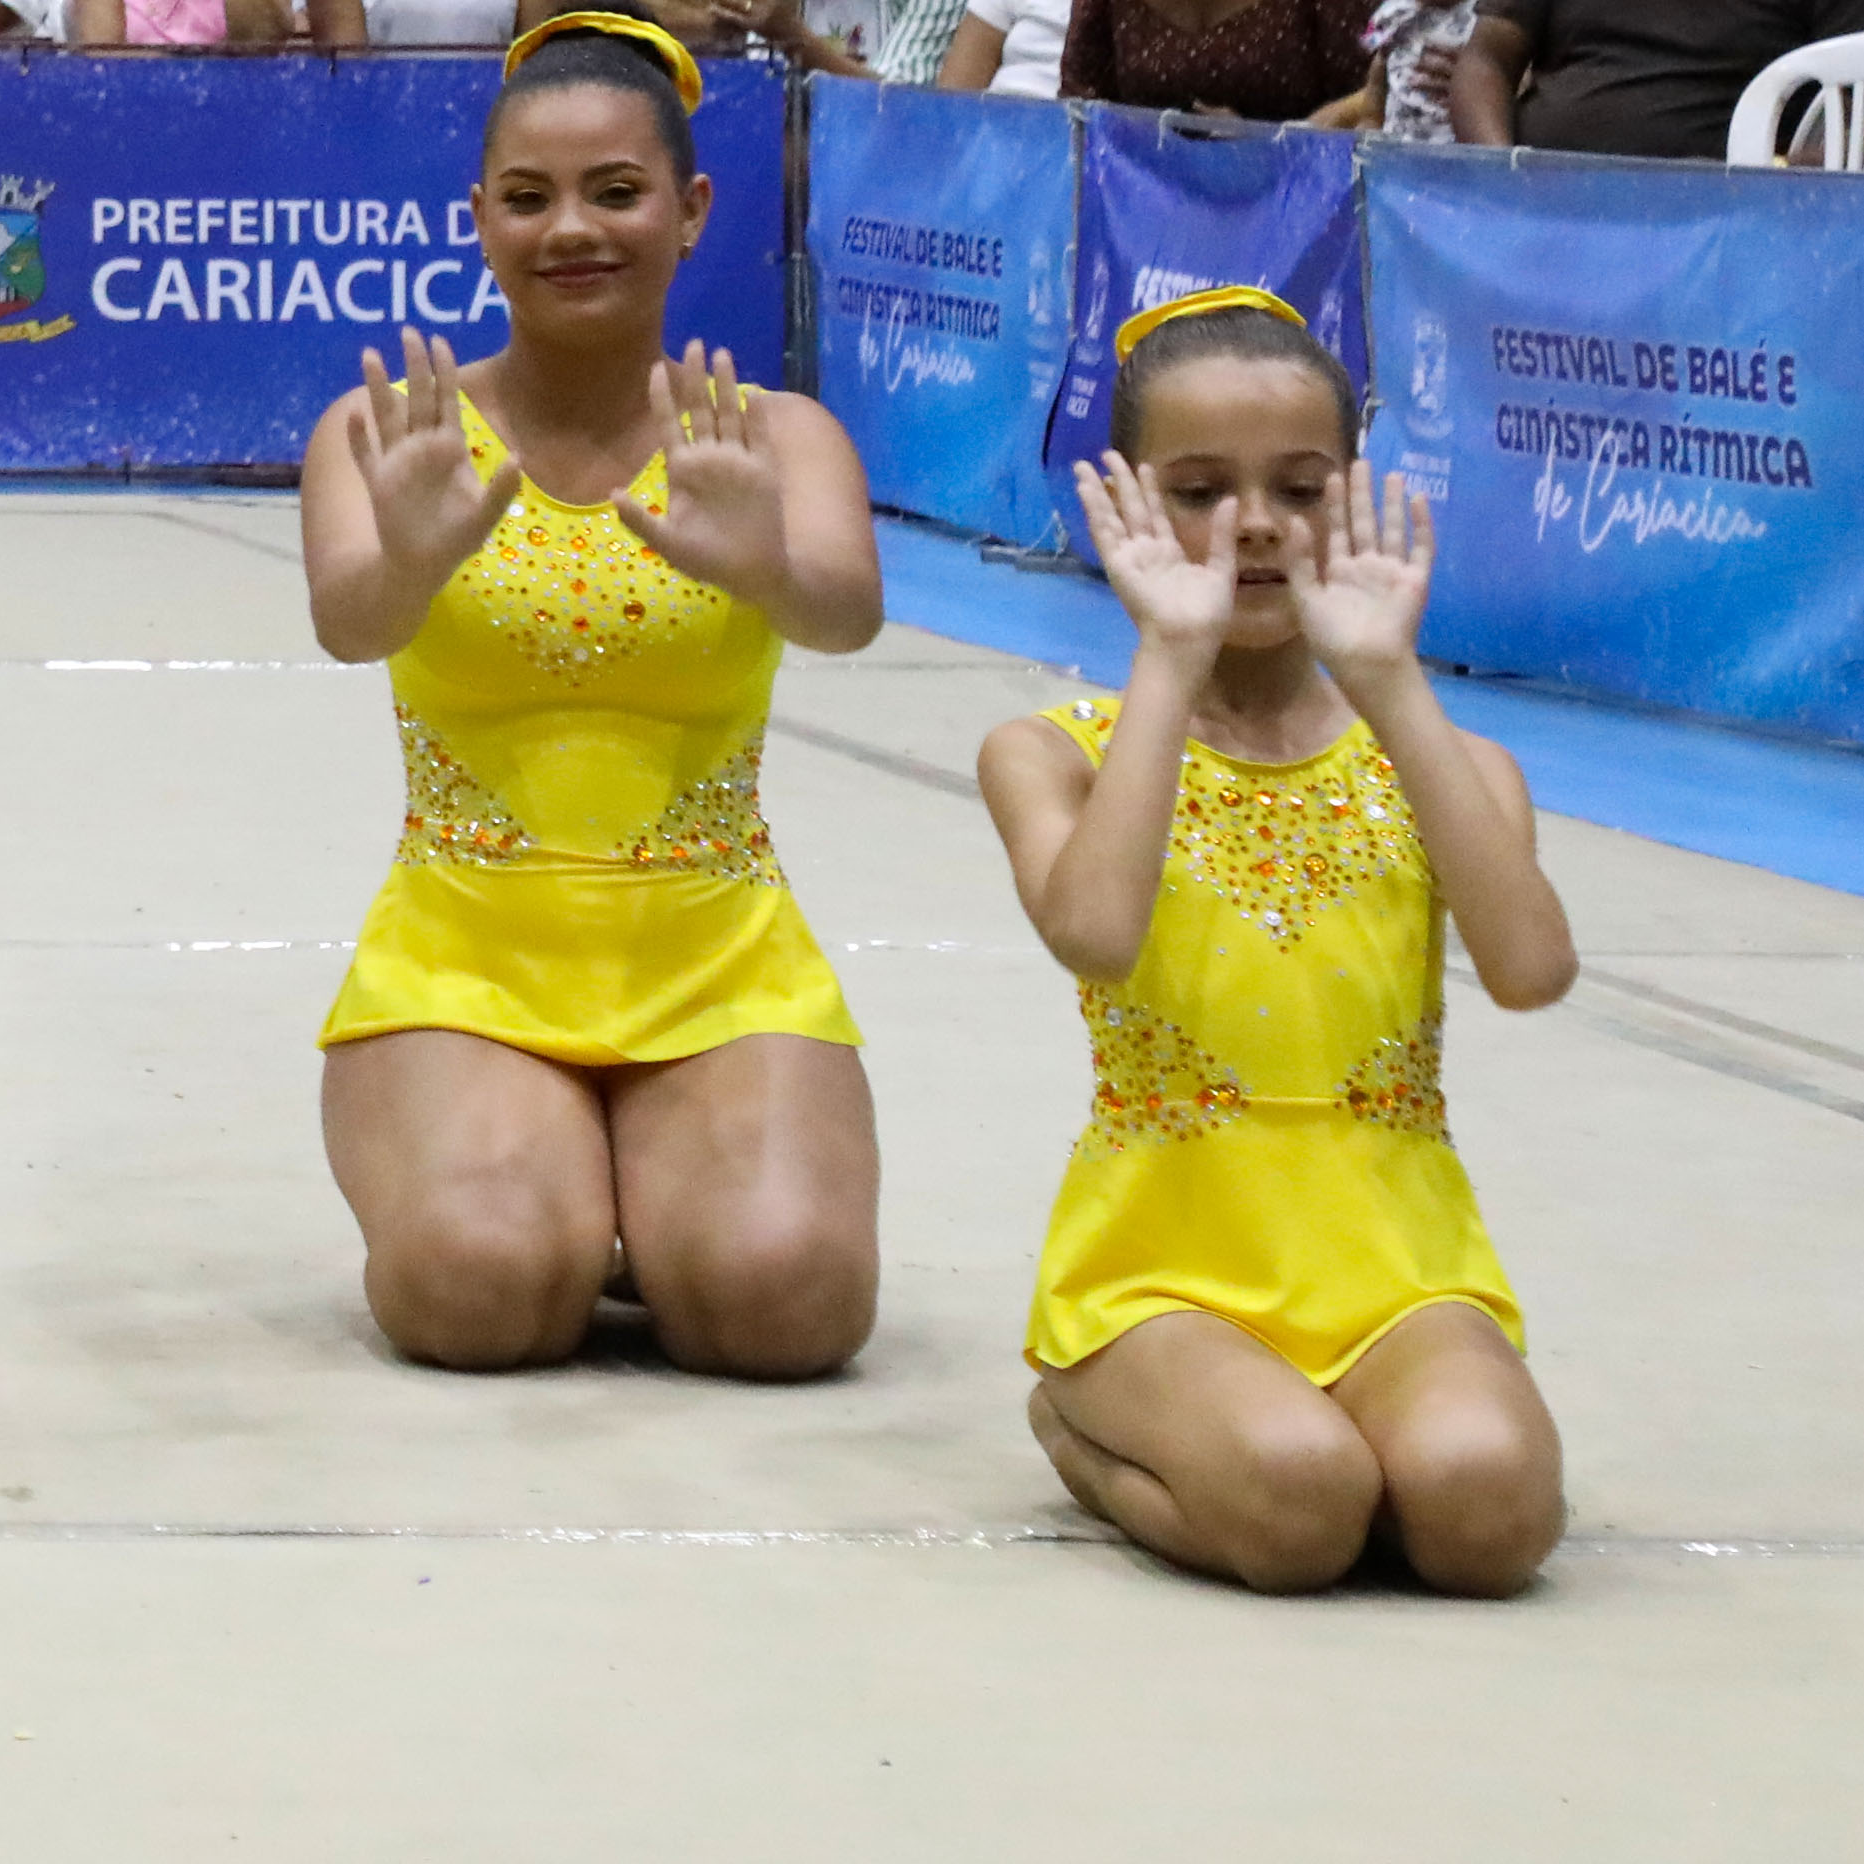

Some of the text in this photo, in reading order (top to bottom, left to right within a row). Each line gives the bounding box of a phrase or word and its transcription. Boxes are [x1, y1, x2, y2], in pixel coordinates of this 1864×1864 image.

[92, 198, 480, 246] PREFEITURA D
[842, 215, 913, 262] FESTIVAL
[916, 227, 939, 268] DE
[91, 257, 511, 323] CARIACICA
[1492, 327, 1798, 406] FESTIVAL DE BALÉ E
[1660, 411, 1814, 487] RÍTMICA
[1534, 429, 1768, 553] de Cariacica
